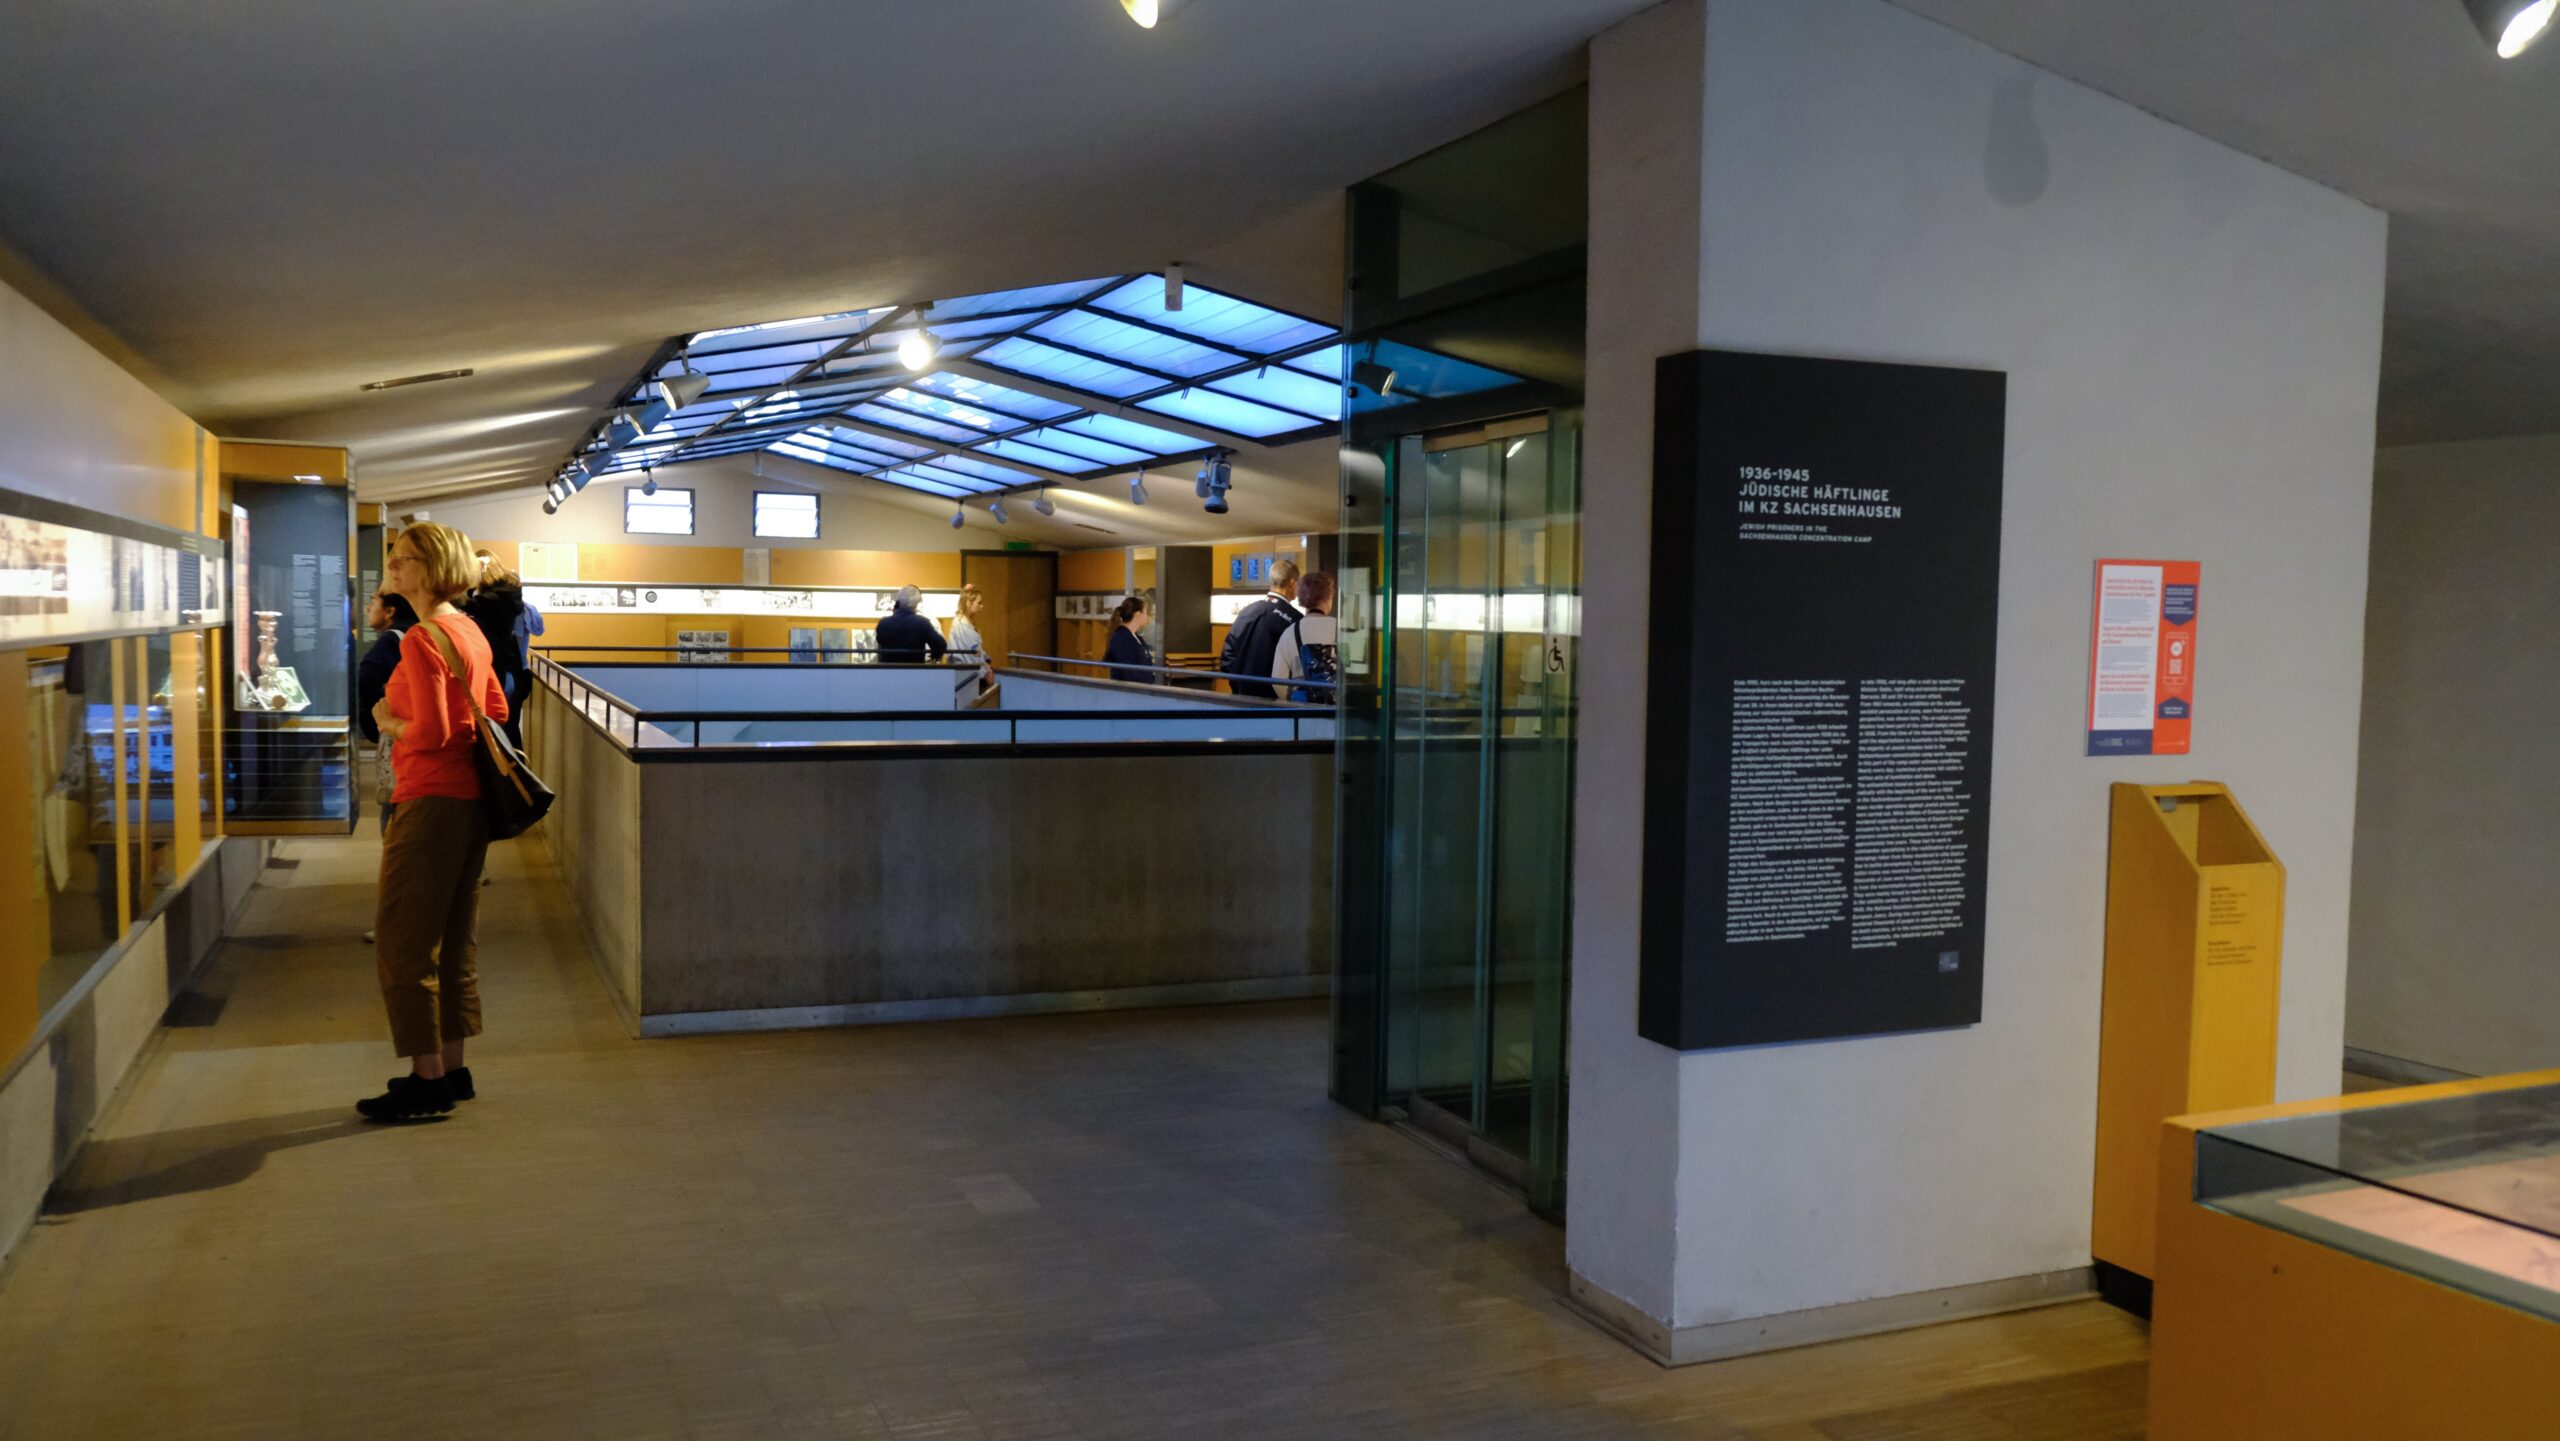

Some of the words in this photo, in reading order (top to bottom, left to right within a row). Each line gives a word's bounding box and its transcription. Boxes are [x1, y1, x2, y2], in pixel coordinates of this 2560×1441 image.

[1739, 466, 1810, 481] 1936-1945
[1739, 481, 1809, 498] JÜDISCHE
[1813, 484, 1889, 501] HÄFTLINGE
[1738, 500, 1755, 513] IM
[1760, 501, 1779, 514] KZ
[1783, 502, 1901, 518] SACHSENHAUSEN
[1767, 524, 1804, 532] PRISONERS
[1815, 525, 1828, 533] THE
[1799, 534, 1853, 542] CONCENTRATION
